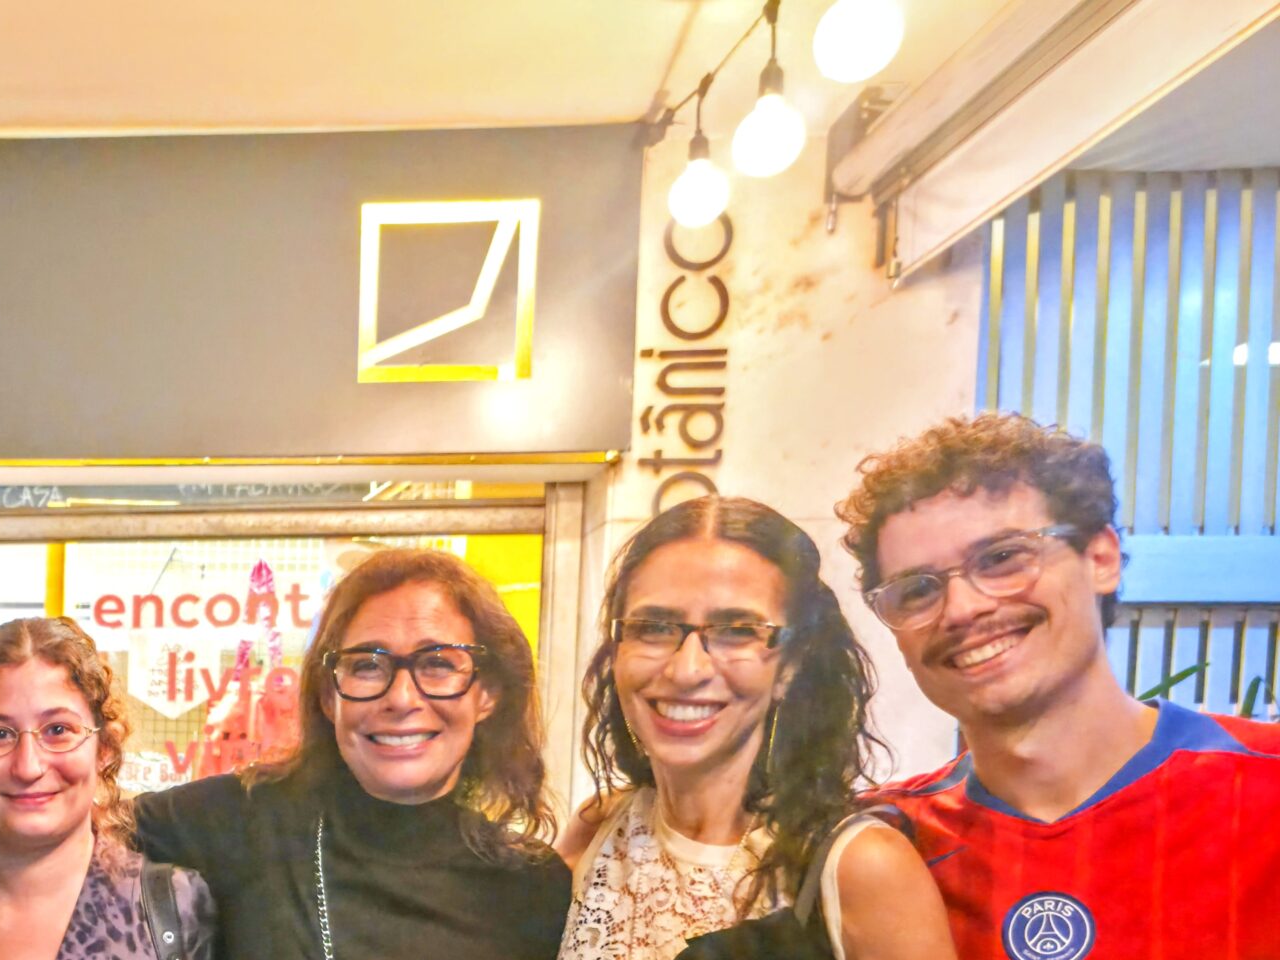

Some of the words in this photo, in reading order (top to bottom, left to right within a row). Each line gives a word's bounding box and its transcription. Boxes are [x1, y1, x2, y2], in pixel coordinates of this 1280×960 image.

[638, 208, 734, 520] otânico
[2, 485, 63, 508] CASA
[93, 582, 313, 629] encont
[1021, 900, 1075, 919] PARIS
